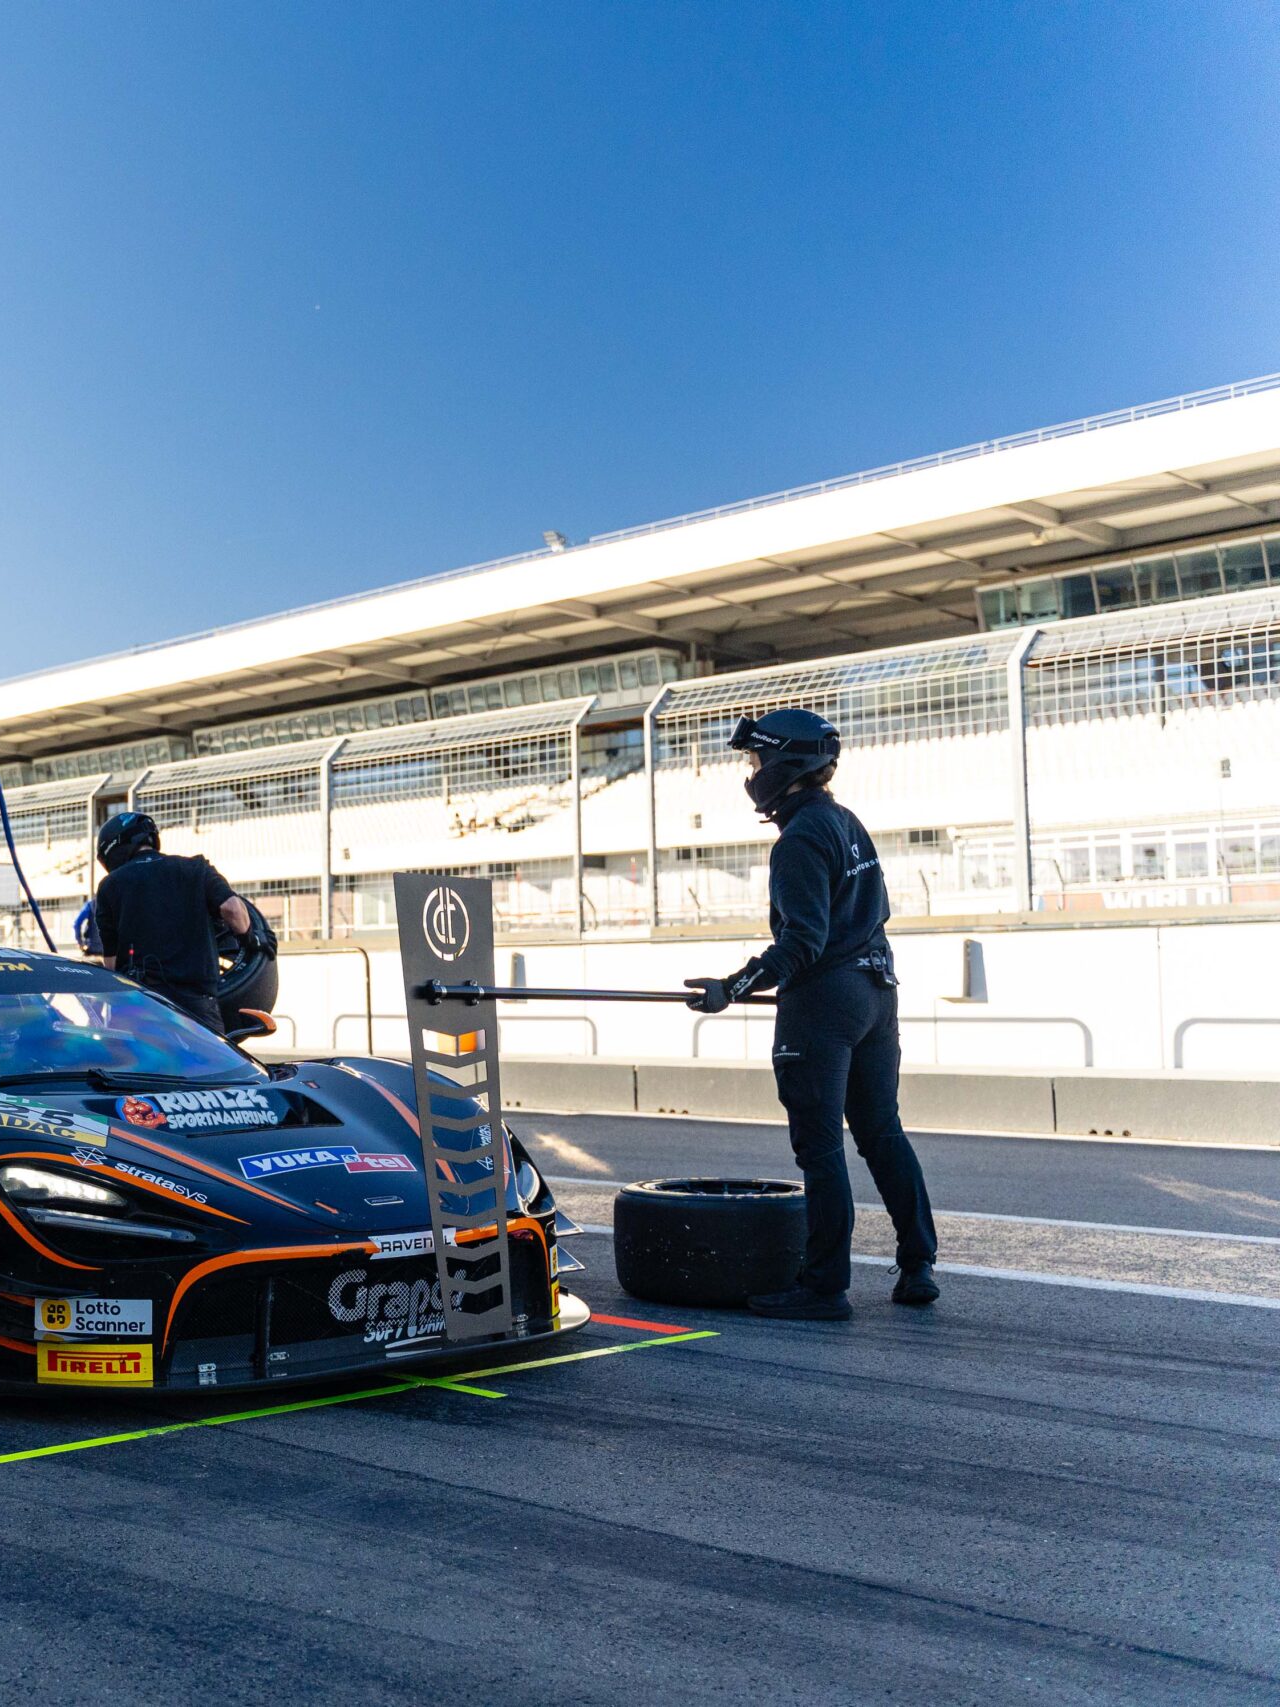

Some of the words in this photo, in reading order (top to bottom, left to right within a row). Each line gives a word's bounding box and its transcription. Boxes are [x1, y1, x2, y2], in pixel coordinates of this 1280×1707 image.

[168, 1109, 279, 1130] SPORTNAHRUNG
[249, 1150, 340, 1172] YUKA
[363, 1156, 408, 1169] tel
[114, 1161, 208, 1204] stratasys
[380, 1236, 452, 1253] RAVENL
[75, 1300, 120, 1316] Lotto
[75, 1316, 146, 1333] Scanner
[47, 1350, 142, 1375] PIRELLI
